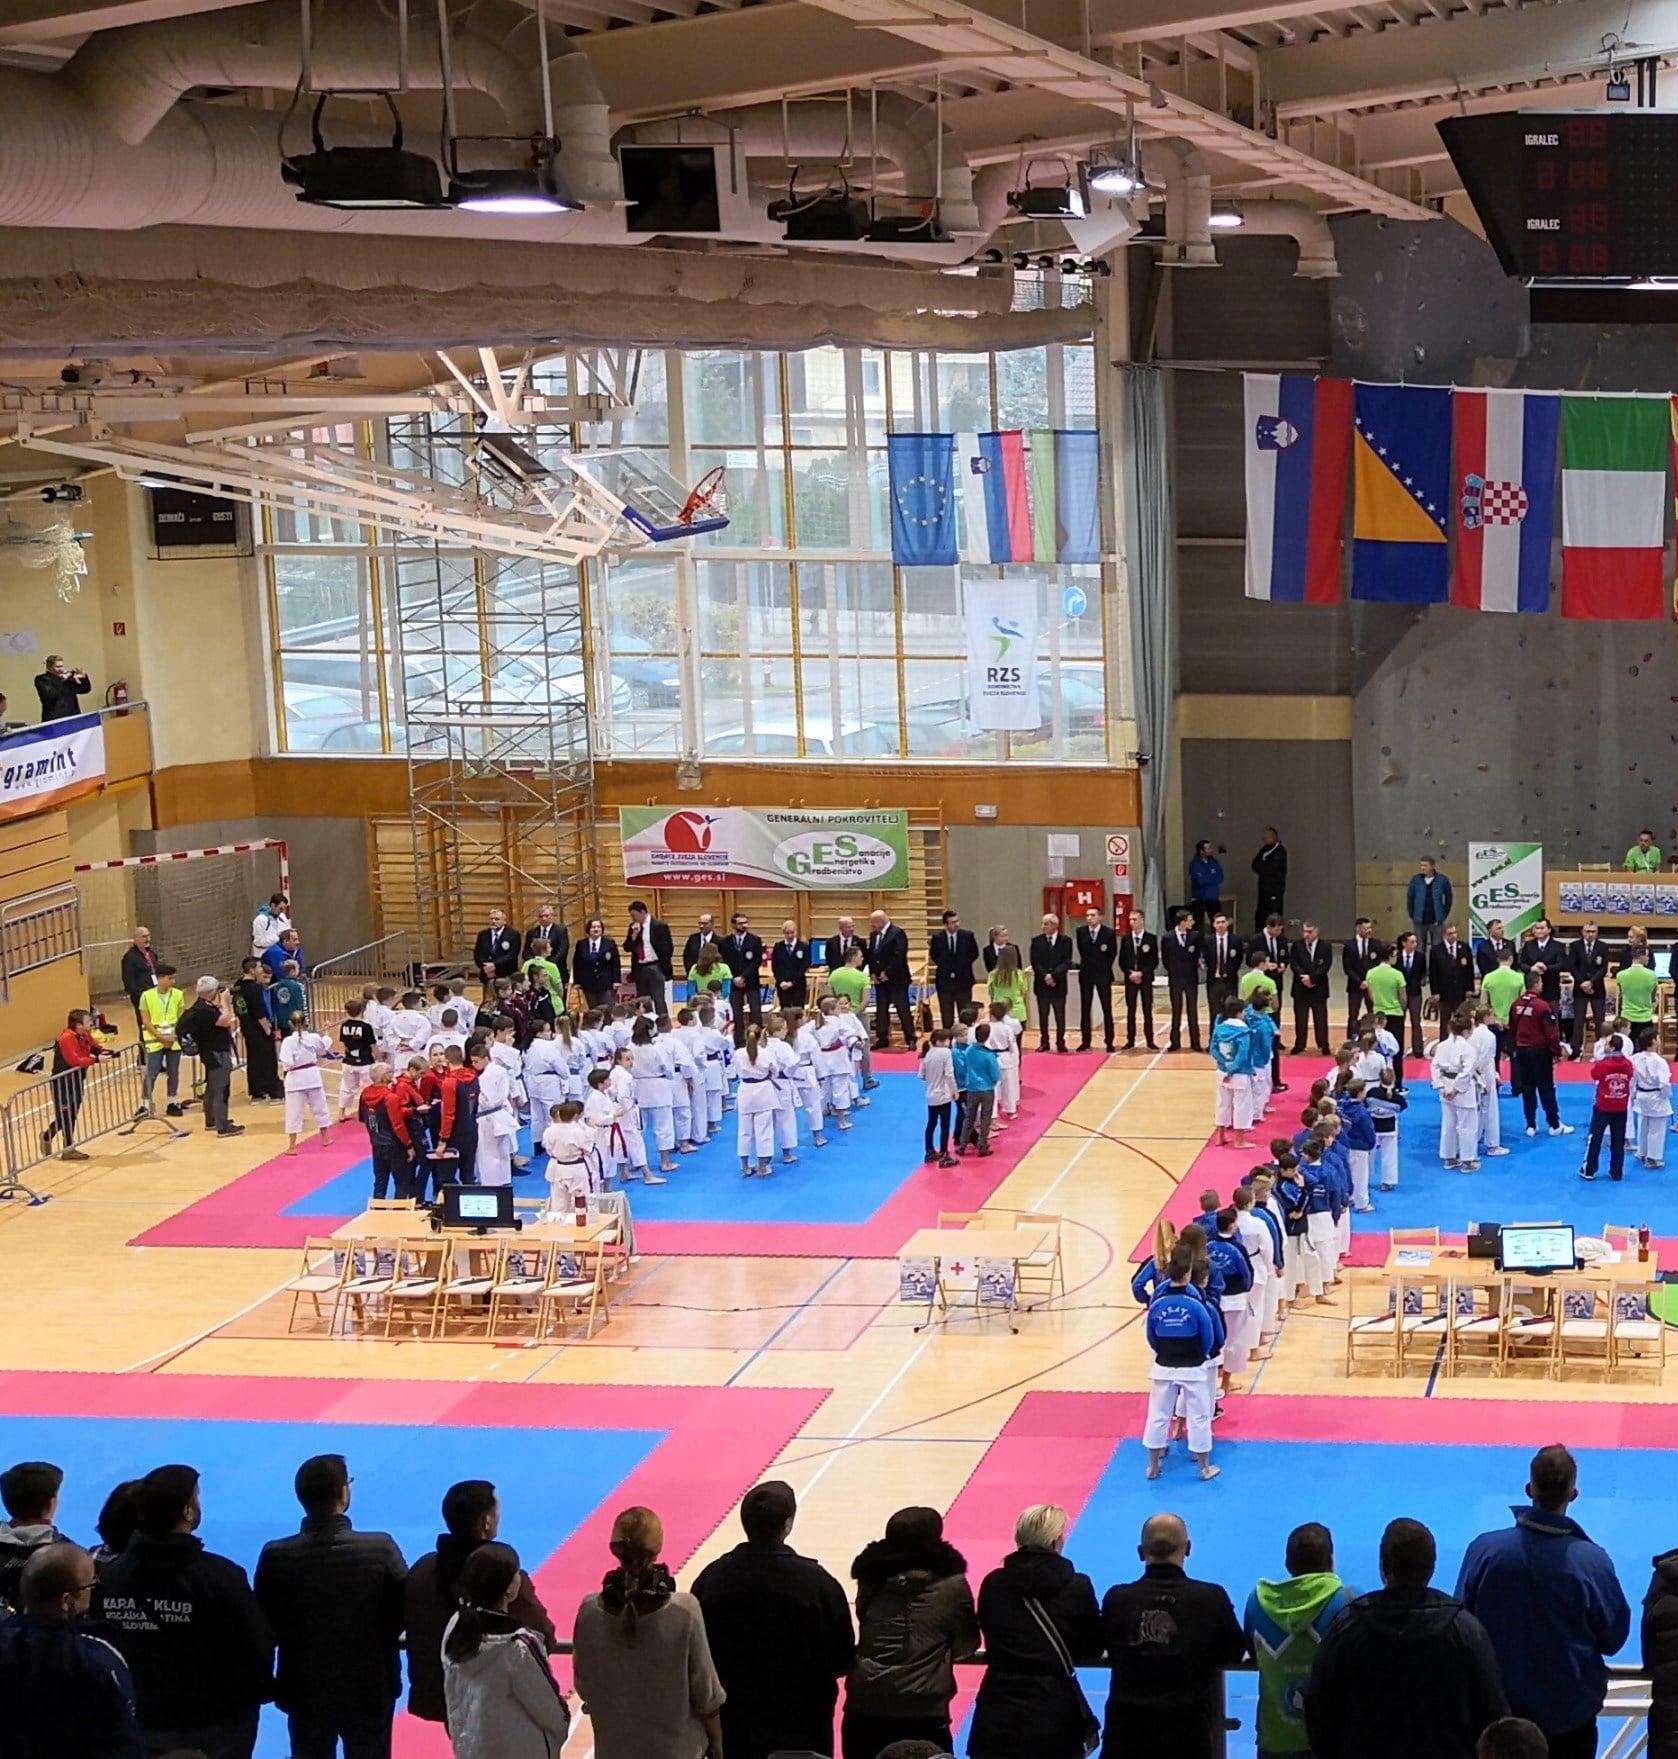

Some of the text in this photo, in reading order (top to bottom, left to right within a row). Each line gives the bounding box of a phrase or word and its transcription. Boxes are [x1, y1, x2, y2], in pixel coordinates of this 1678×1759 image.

[1525, 134, 1559, 146] IGRALEC
[1526, 219, 1560, 230] IGRALEC
[987, 667, 1021, 682] RZS
[4, 748, 77, 789] gramint
[766, 814, 898, 824] GENERALNI POKROVITELJ
[786, 834, 859, 875] GES
[663, 873, 726, 883] www.ges.si
[1078, 892, 1092, 904] H
[1472, 883, 1520, 909] GES
[103, 1598, 192, 1614] KARA KLUB
